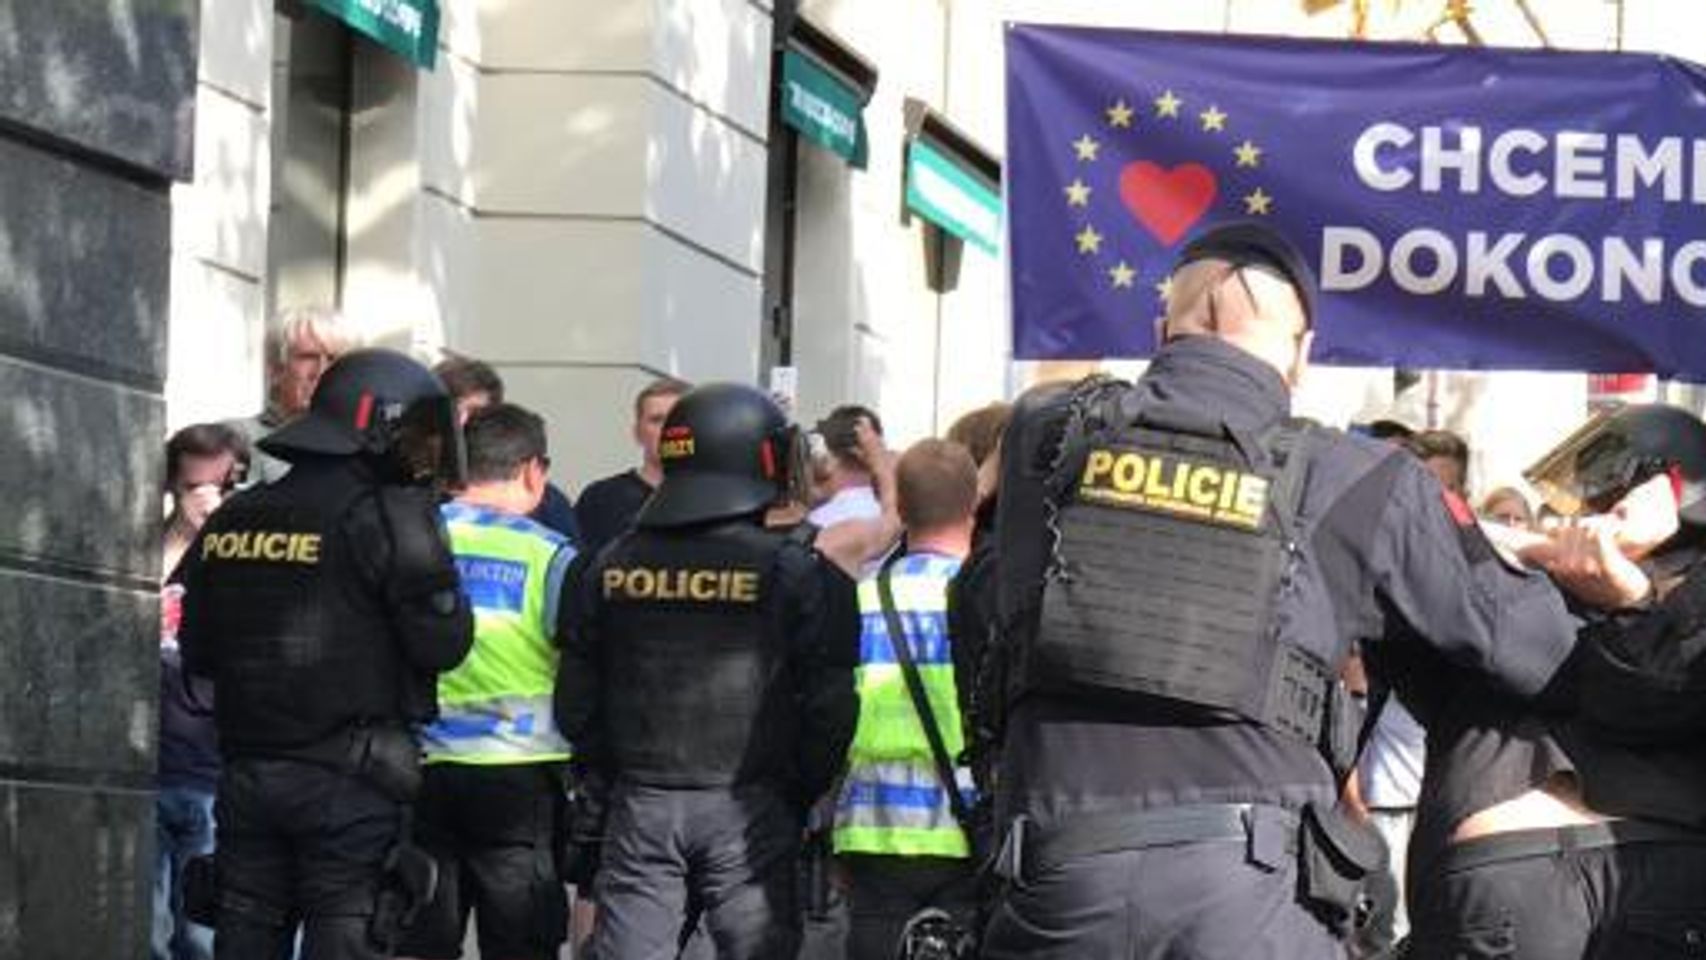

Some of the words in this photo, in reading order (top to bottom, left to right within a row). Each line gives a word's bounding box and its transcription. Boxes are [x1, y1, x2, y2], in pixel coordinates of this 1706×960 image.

[1082, 449, 1269, 516] POLICIE
[202, 530, 322, 564] POLICIE
[602, 568, 760, 601] POLICIE
